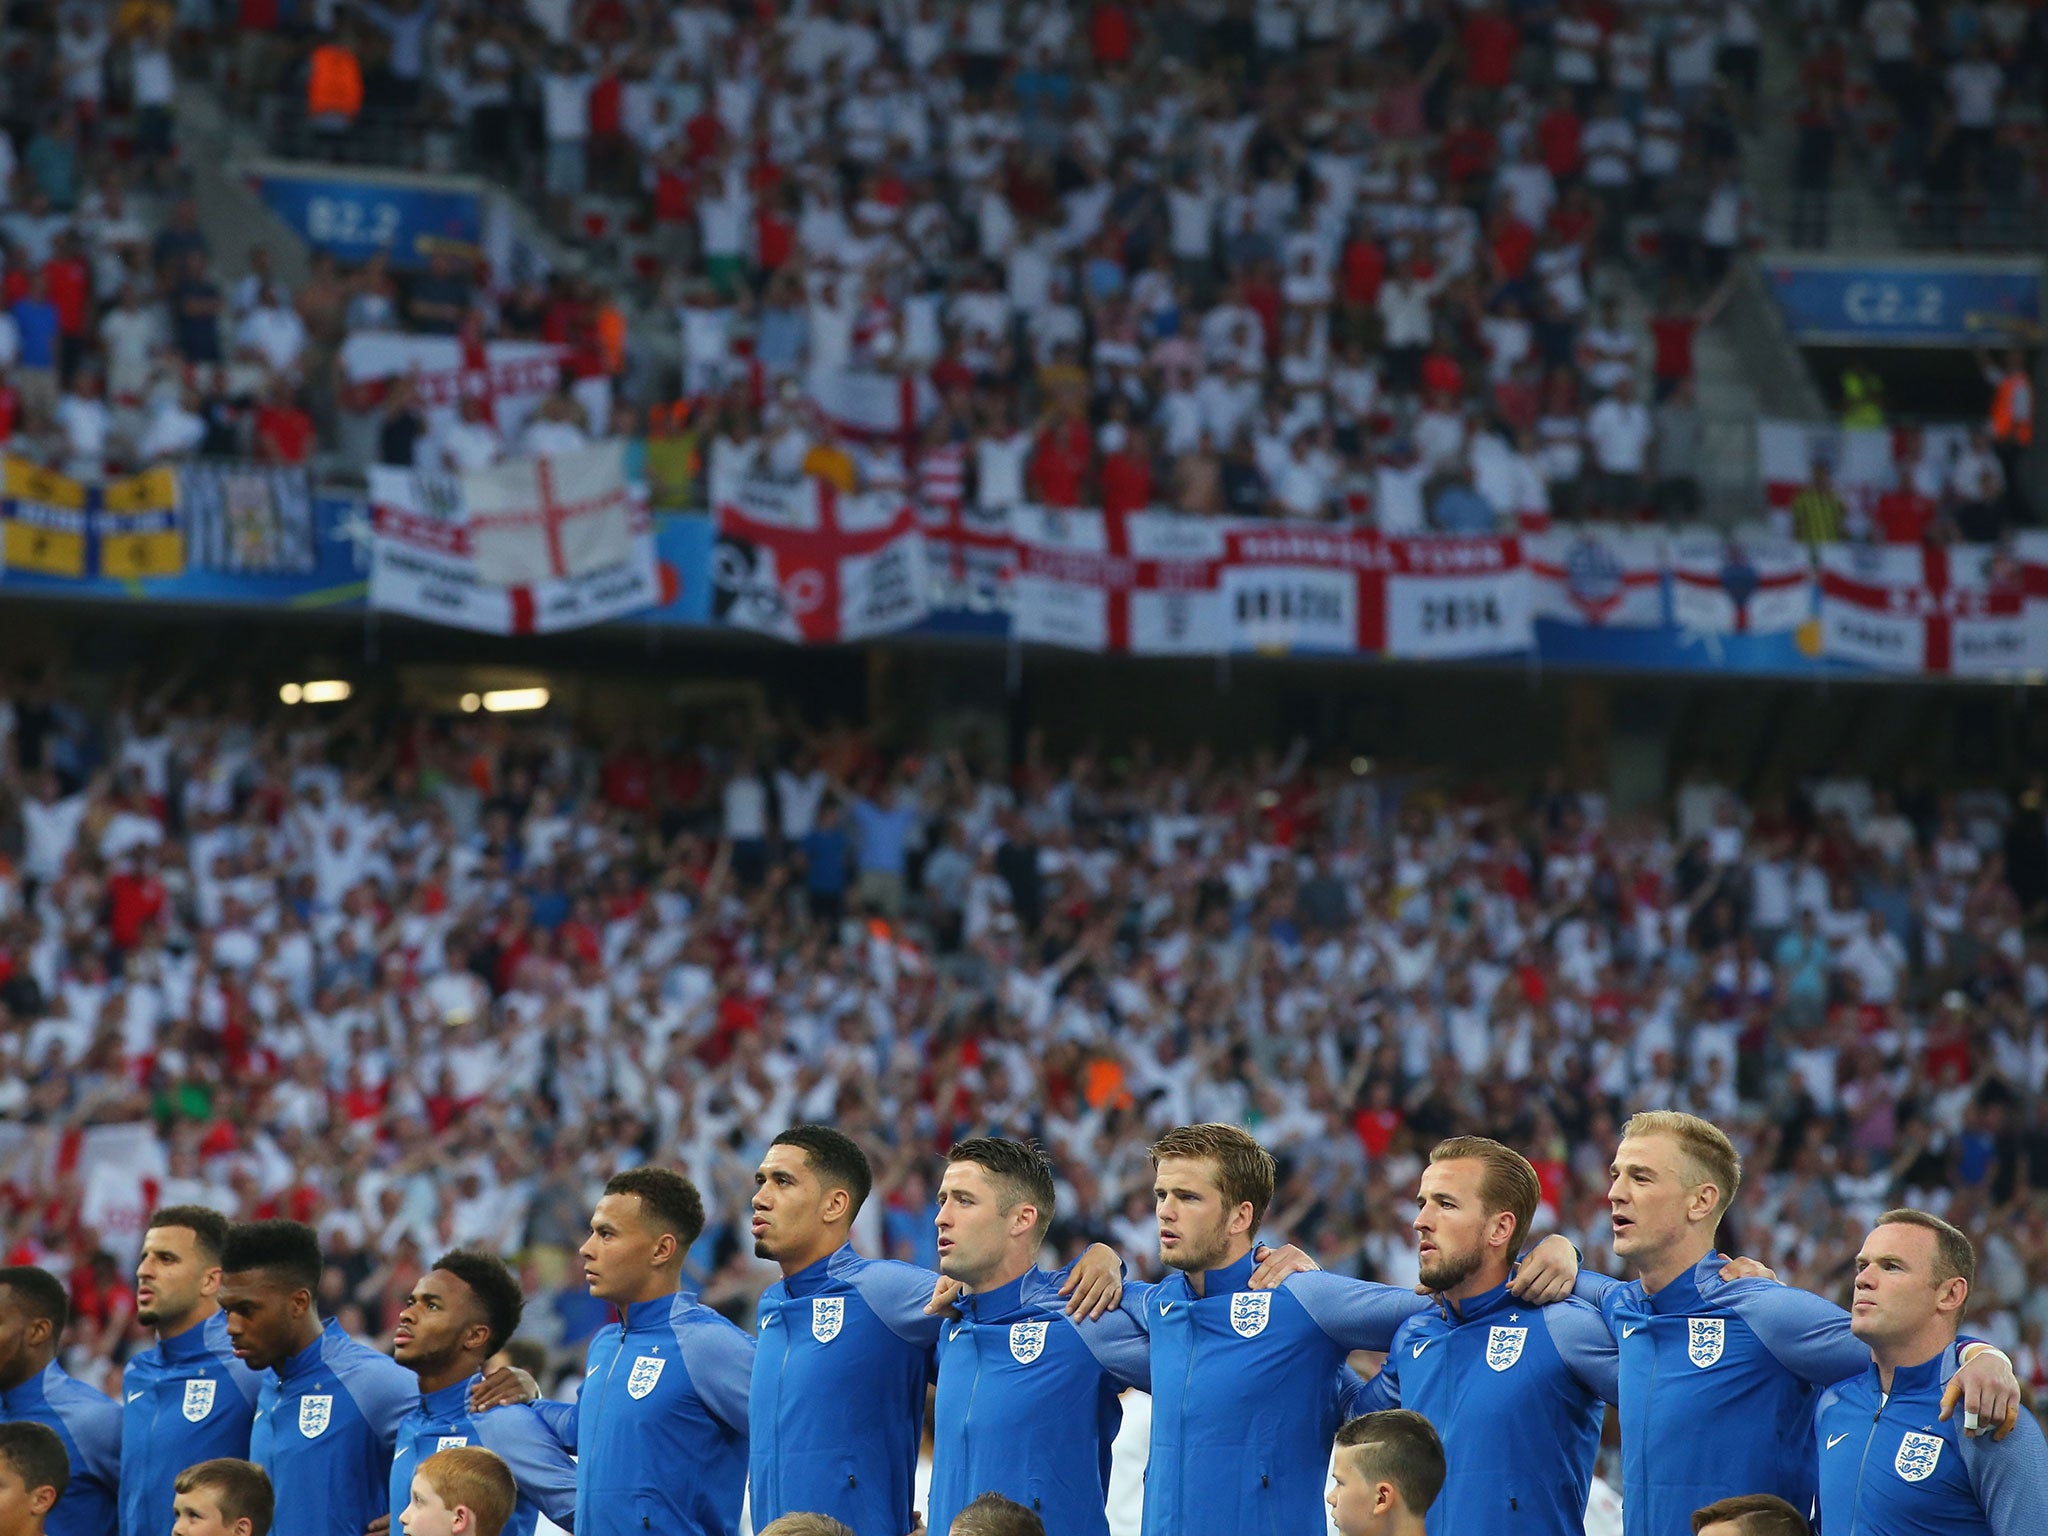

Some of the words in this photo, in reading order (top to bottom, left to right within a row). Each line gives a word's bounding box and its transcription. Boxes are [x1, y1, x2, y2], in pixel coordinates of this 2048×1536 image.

[306, 197, 400, 243] B2.2
[1844, 281, 1944, 324] C2.2
[1408, 541, 1504, 570] TOWN
[1422, 597, 1501, 633] 2014
